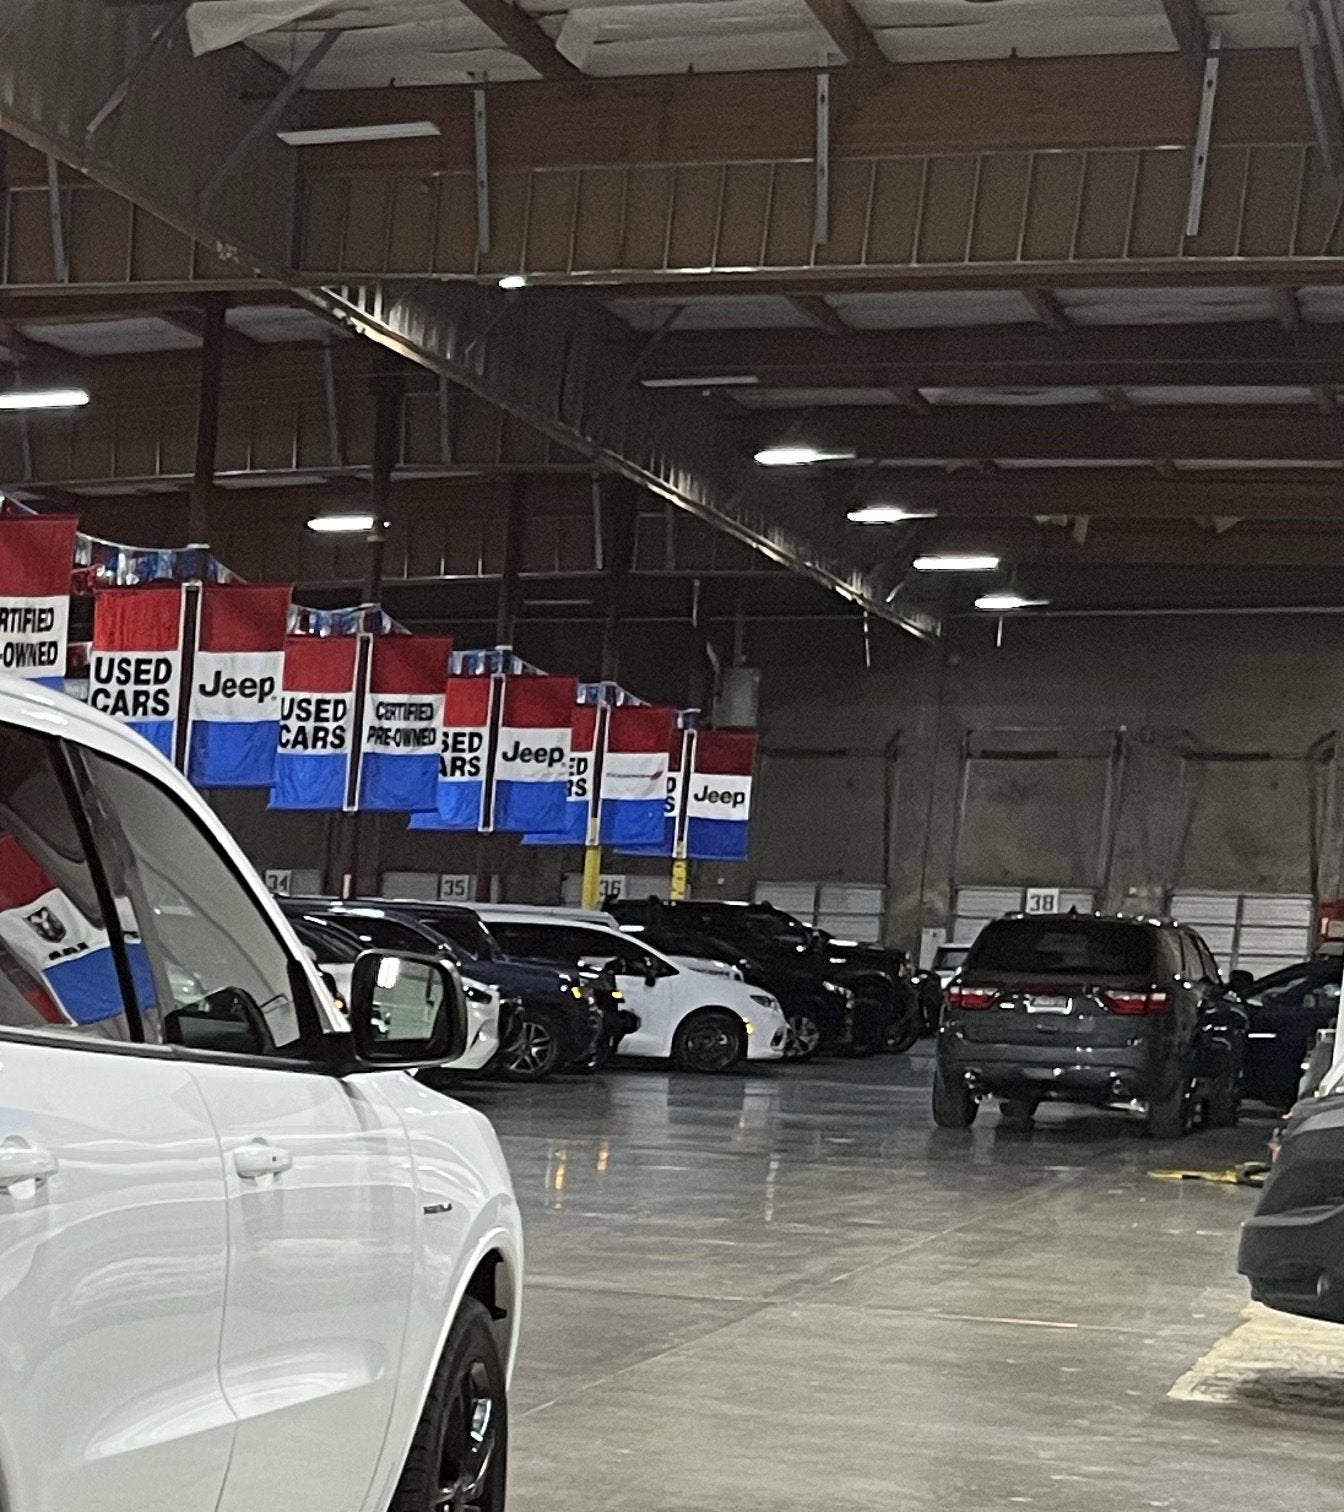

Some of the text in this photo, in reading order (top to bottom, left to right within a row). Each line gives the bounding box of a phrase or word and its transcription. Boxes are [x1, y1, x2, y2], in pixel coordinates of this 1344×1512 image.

[94, 657, 172, 686] USED
[199, 670, 275, 703] Jeep
[91, 688, 170, 717] CARS
[281, 697, 347, 722] USED
[376, 702, 434, 721] CERTIFIED
[279, 724, 346, 749] CARS
[367, 726, 437, 747] PRE-OWNED
[502, 741, 564, 767] Jeep
[693, 785, 745, 808] Jeep
[268, 874, 288, 893] 34
[444, 880, 465, 896] 35
[600, 880, 621, 897] 36
[1029, 894, 1055, 911] 38
